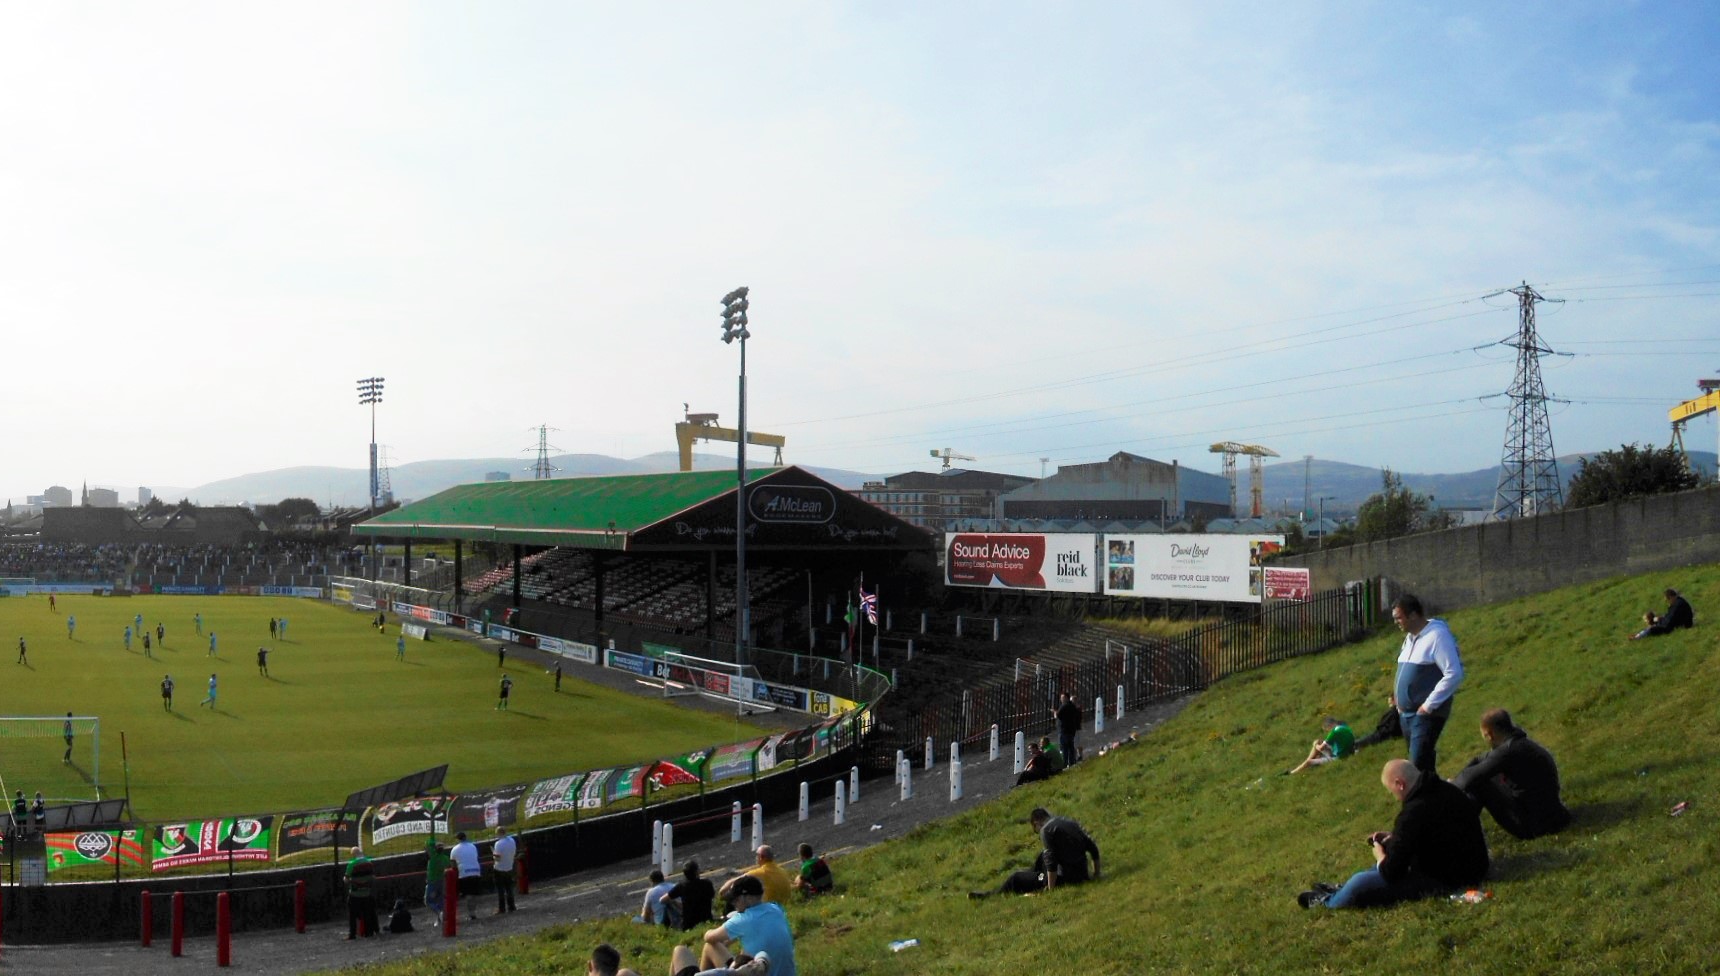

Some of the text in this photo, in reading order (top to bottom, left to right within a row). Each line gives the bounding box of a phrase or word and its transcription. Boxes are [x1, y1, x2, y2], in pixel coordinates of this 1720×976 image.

[765, 495, 822, 512] A.McLean
[954, 542, 1030, 559] Sound Advice
[1170, 542, 1210, 558] David Lloyd
[1057, 550, 1080, 564] reid
[986, 561, 1003, 569] Claims
[1004, 562, 1024, 570] Experts
[1057, 564, 1088, 577] black
[1151, 573, 1177, 581] DISCOVER
[1178, 574, 1194, 582] YOUR
[1211, 575, 1231, 583] TODAY
[813, 703, 828, 714] CAB
